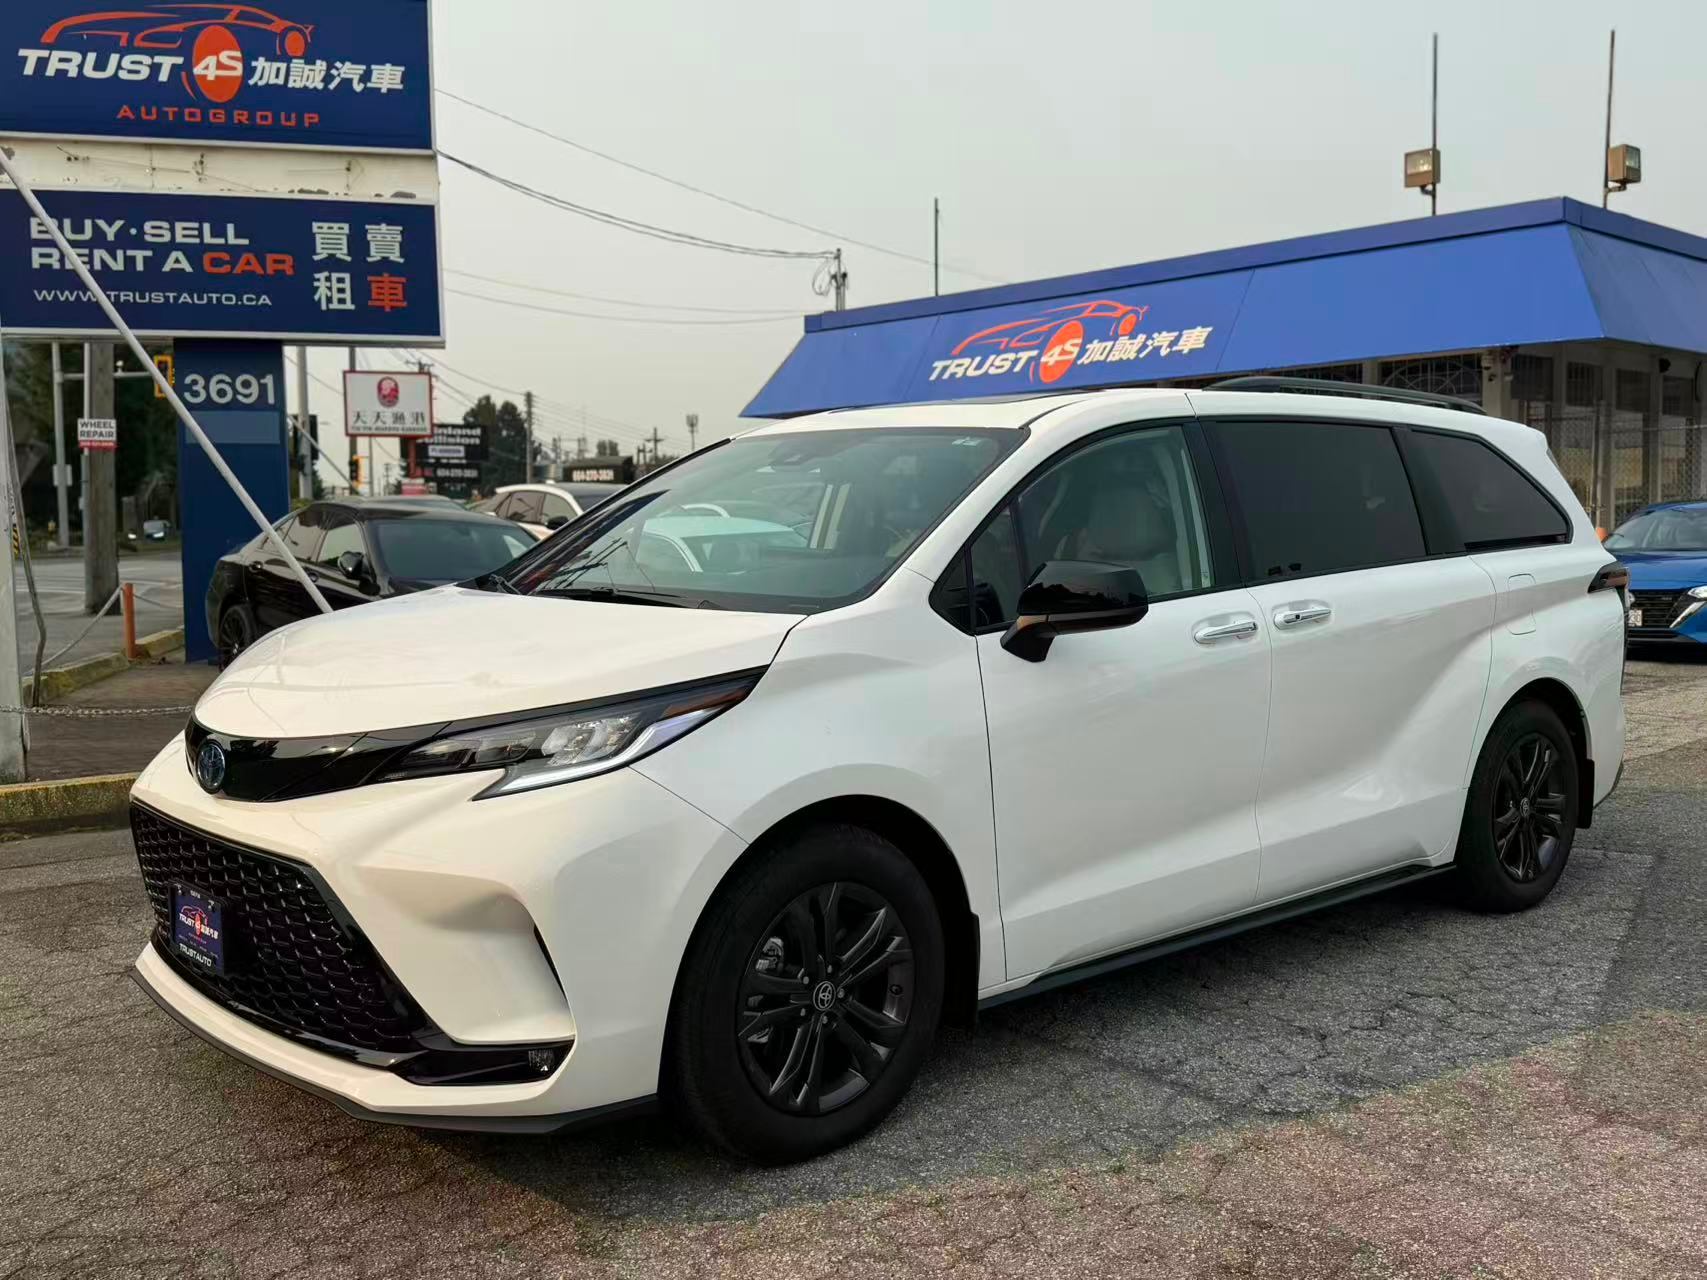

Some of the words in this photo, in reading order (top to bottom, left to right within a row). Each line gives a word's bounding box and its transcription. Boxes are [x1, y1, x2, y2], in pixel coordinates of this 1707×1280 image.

[17, 48, 184, 82] TRUST
[193, 50, 243, 81] 4S
[248, 57, 405, 93] 加誠汽車
[116, 105, 320, 127] AUTOGROUP
[31, 247, 153, 272] RENT
[161, 250, 194, 273] A
[203, 251, 295, 276] CAR
[33, 289, 272, 306] WWWTRUSTAUTO.CA
[928, 349, 1039, 381] TRUST
[1040, 338, 1083, 365] 4S
[1077, 326, 1213, 365] 加誠汽車
[183, 373, 275, 405] 3691
[79, 420, 115, 429] WHEEL
[79, 430, 114, 438] REPAIR
[179, 943, 212, 967] TRUSTAUTO
